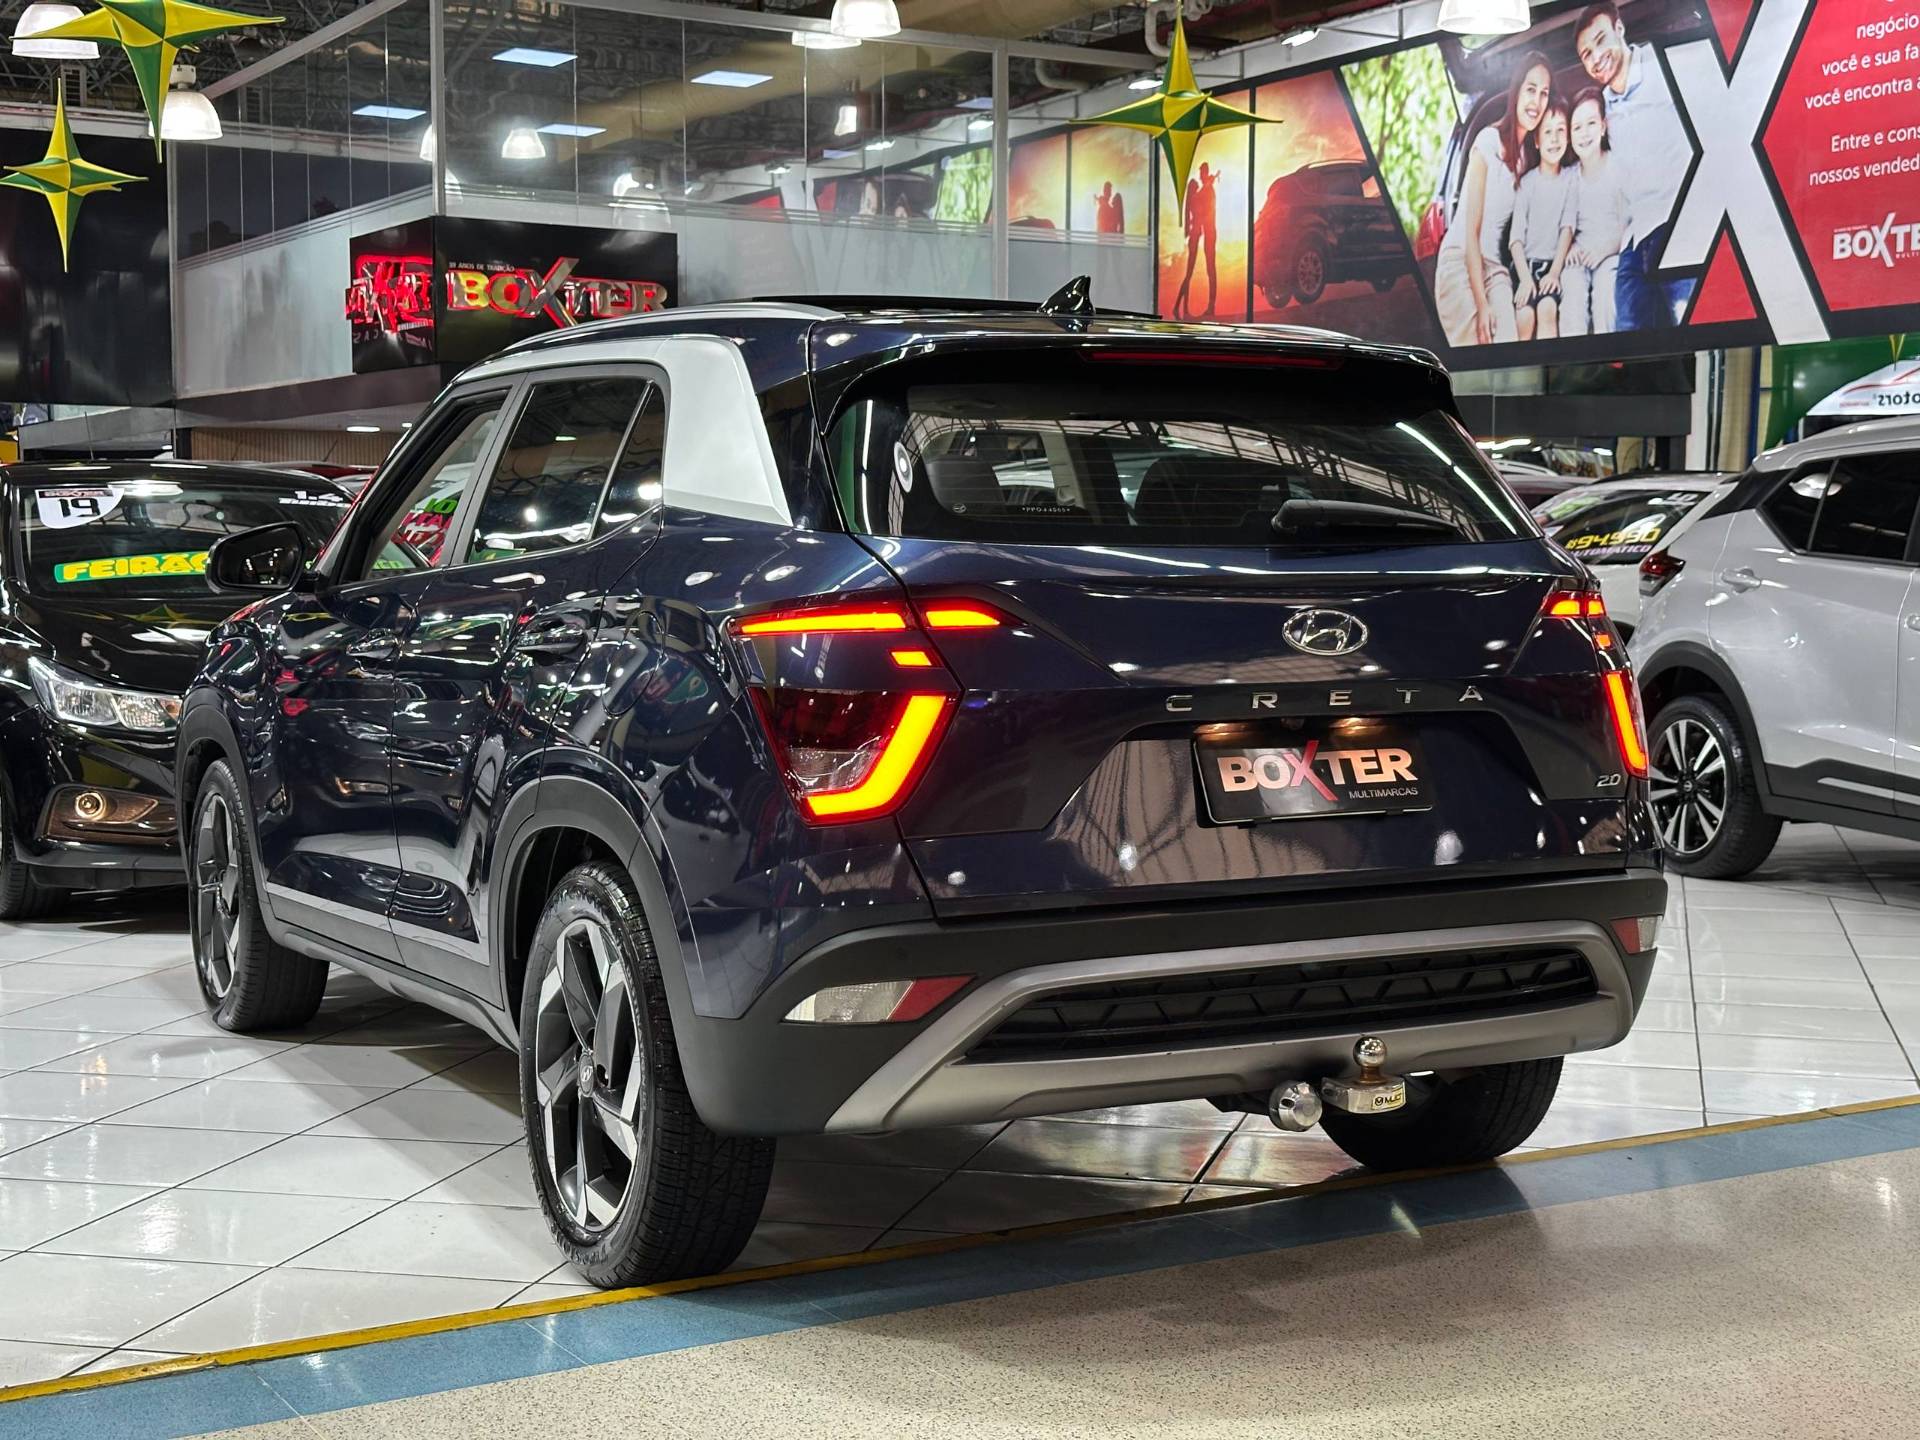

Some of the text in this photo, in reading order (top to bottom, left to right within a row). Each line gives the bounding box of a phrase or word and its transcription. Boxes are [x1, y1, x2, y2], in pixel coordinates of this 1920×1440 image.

[1856, 12, 1919, 39] negócio
[1821, 53, 1858, 76] você
[1861, 55, 1871, 69] e
[1874, 49, 1900, 67] sua
[1804, 88, 1841, 109] você
[1844, 78, 1913, 102] encontra
[1831, 134, 1871, 153] Entre
[1874, 132, 1884, 146] e
[1809, 166, 1860, 186] nossos
[445, 257, 668, 328] BOXTER
[59, 498, 101, 518] 19
[1165, 684, 1484, 712] CRETA
[1216, 740, 1418, 800] BOXTER
[1348, 787, 1418, 799] MULTIMARCAS
